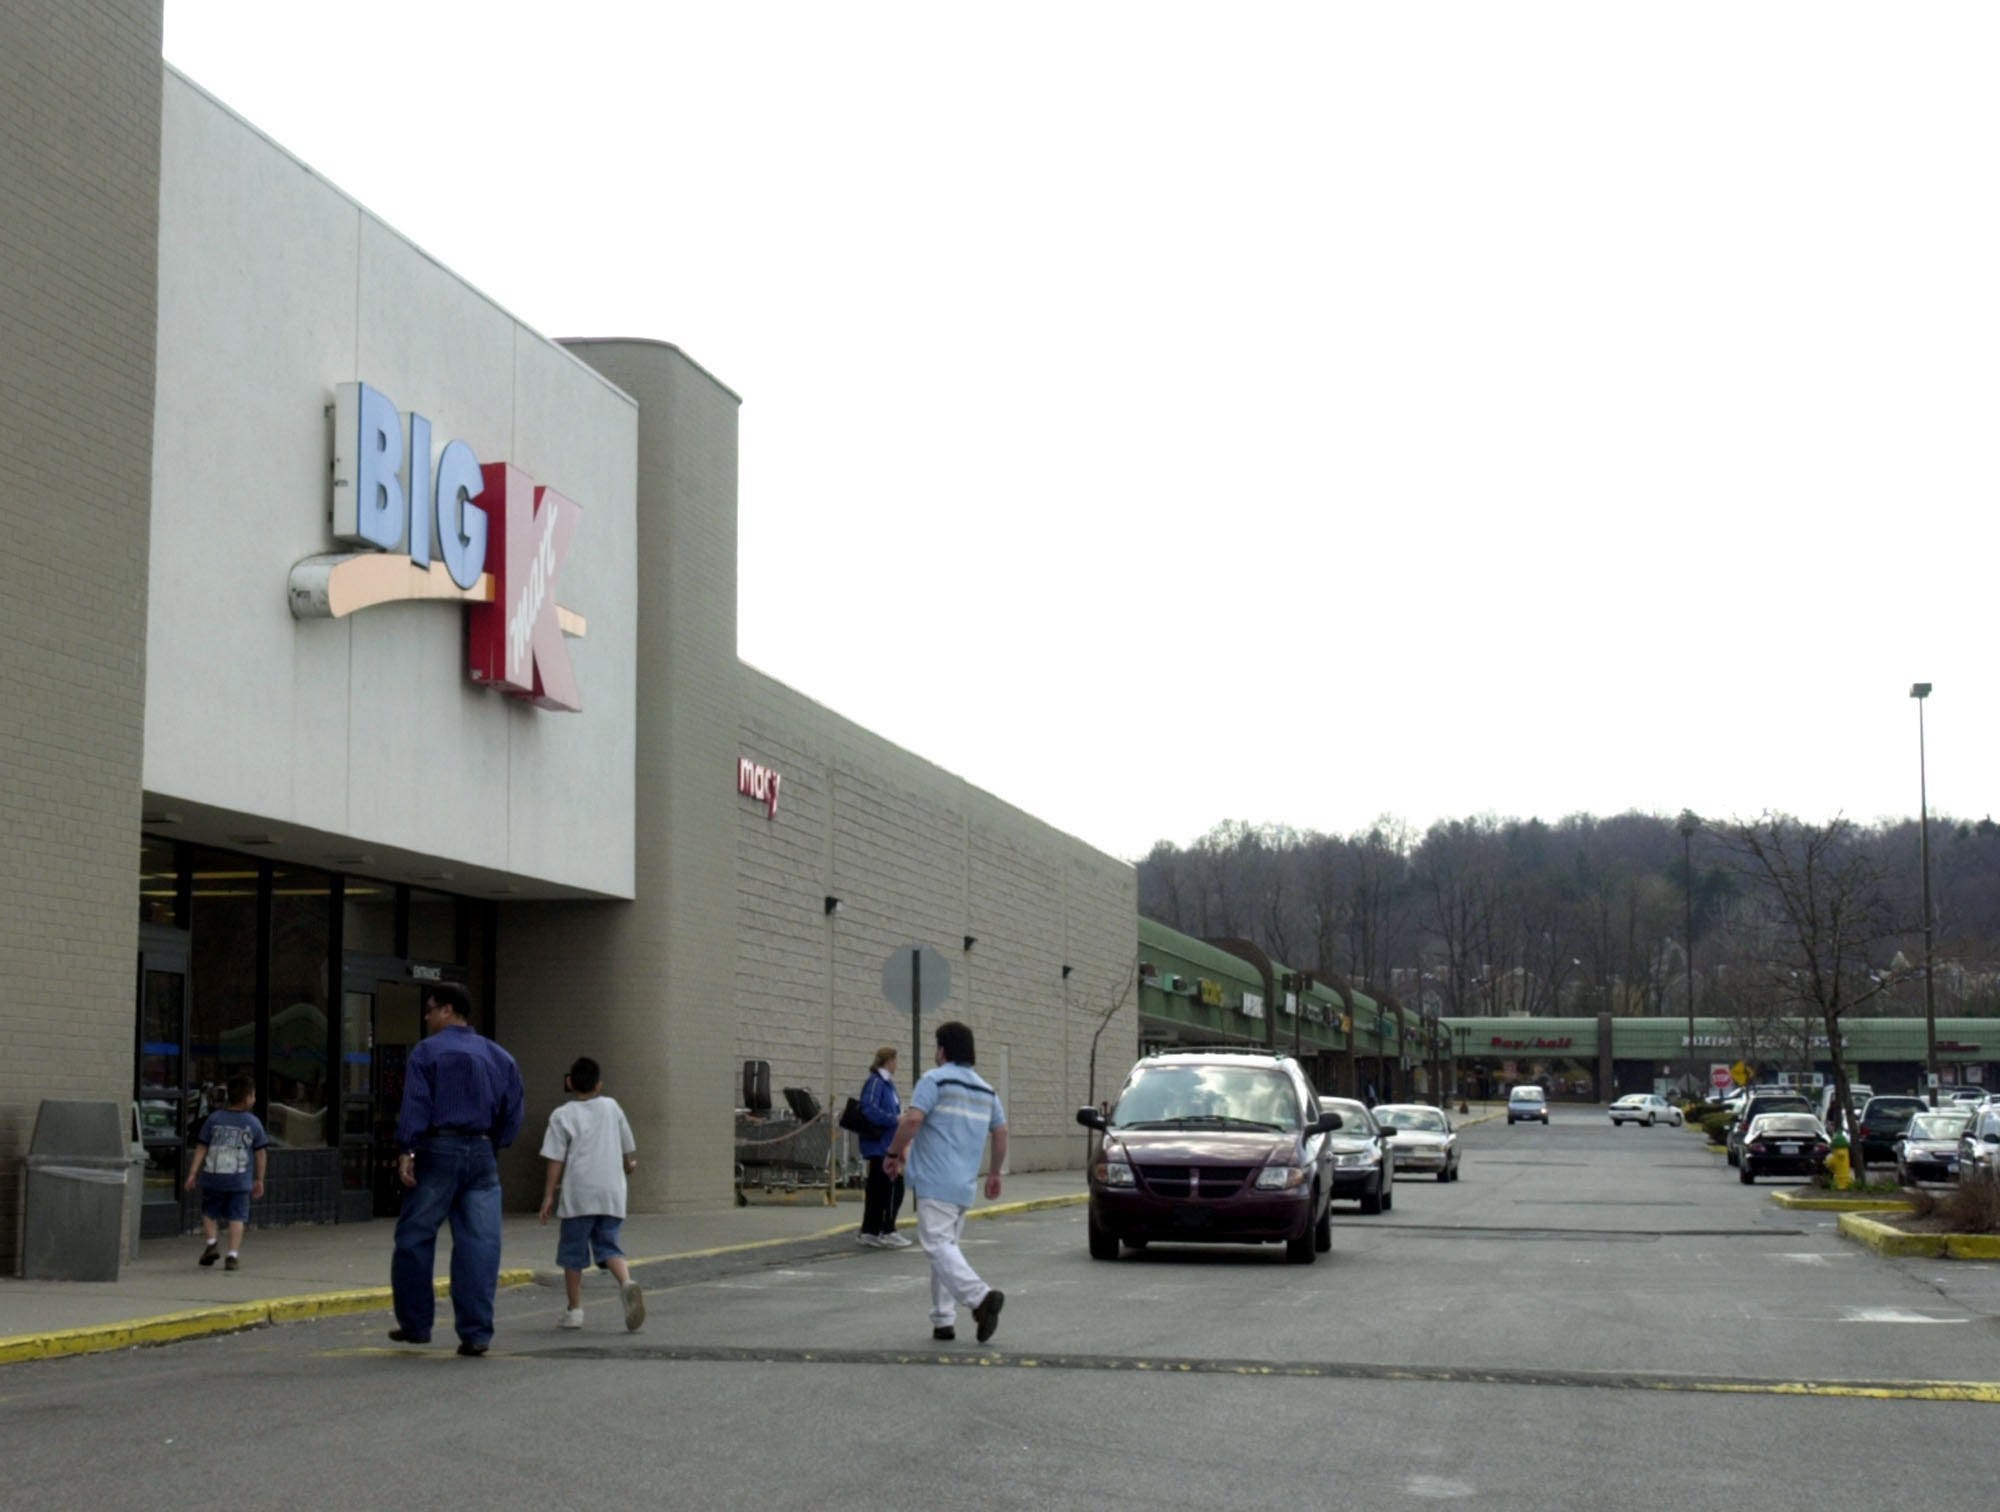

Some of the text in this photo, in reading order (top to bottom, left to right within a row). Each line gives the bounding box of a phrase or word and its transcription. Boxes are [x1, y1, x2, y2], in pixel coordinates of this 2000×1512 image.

[356, 381, 583, 713] BIG K
[738, 757, 781, 817] macy
